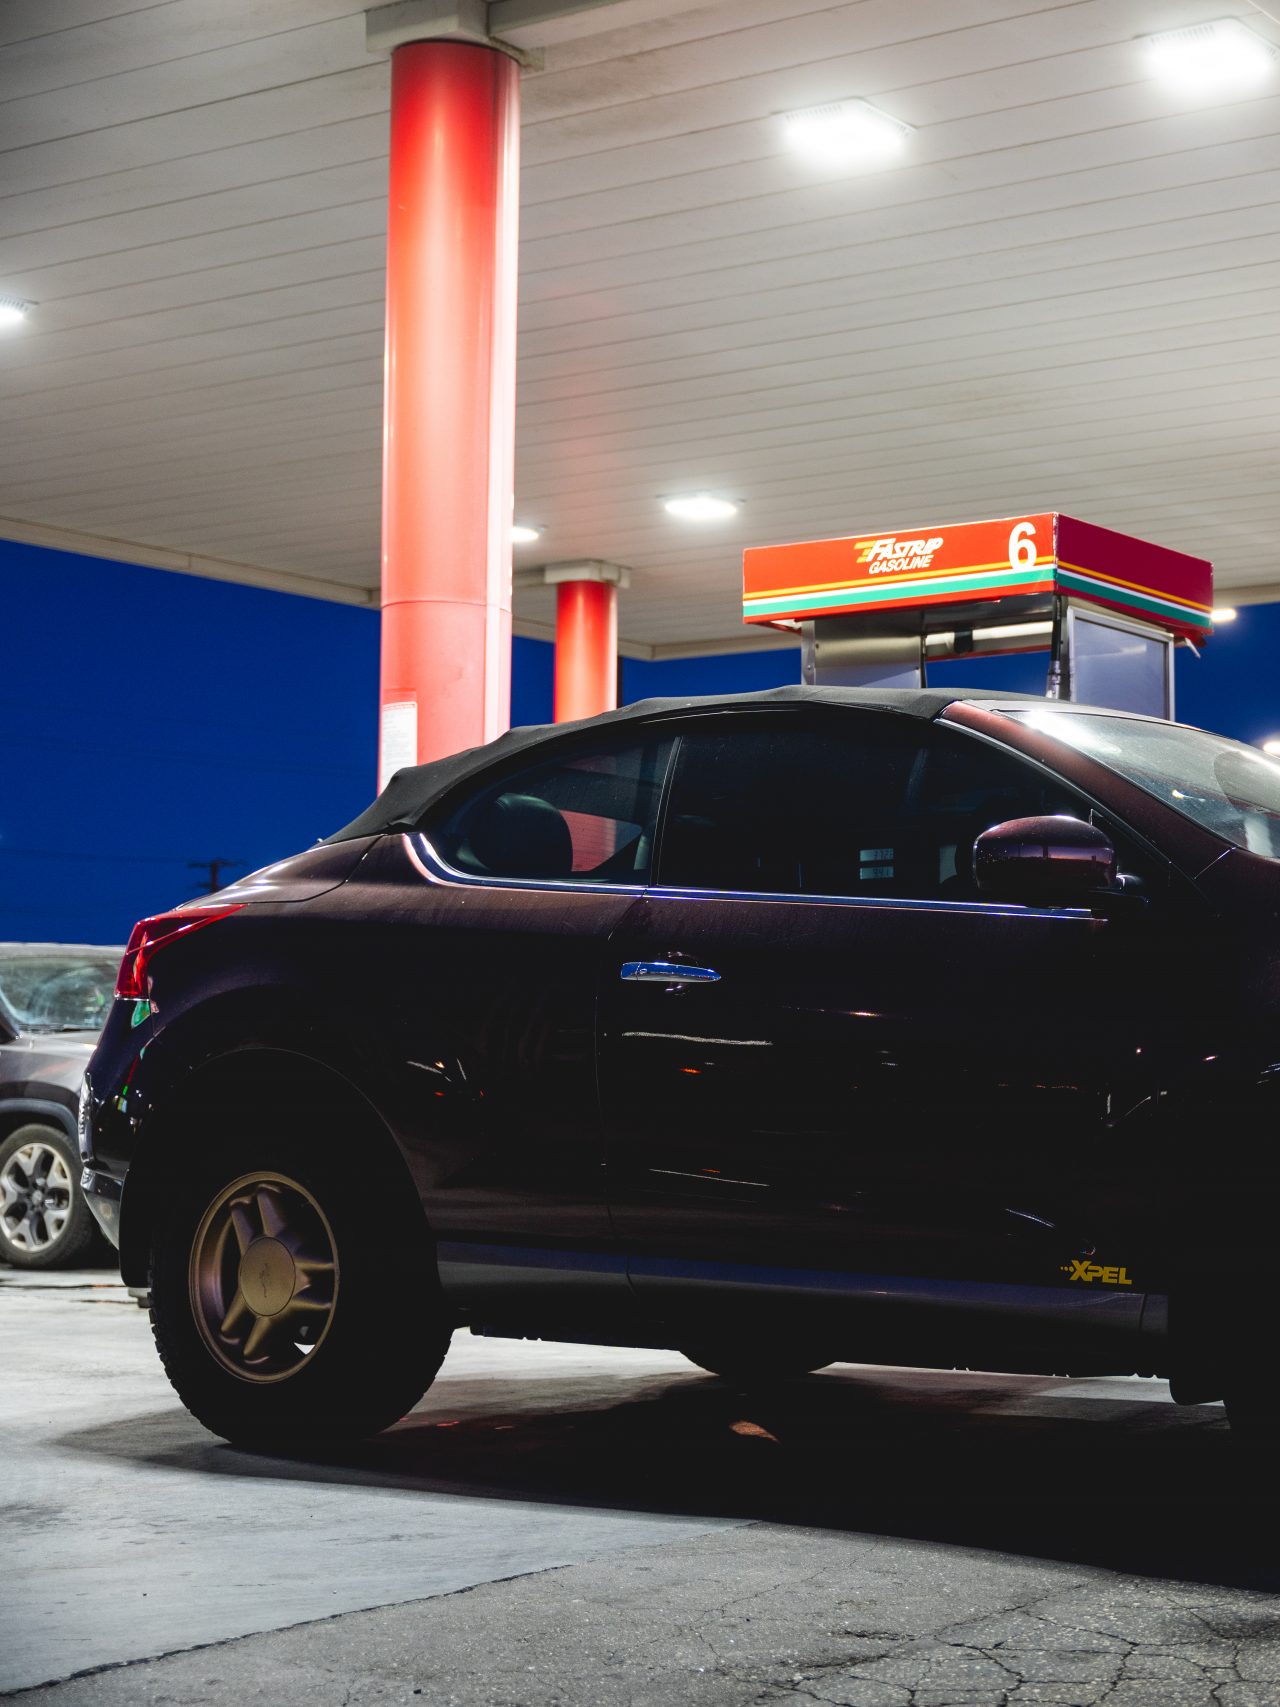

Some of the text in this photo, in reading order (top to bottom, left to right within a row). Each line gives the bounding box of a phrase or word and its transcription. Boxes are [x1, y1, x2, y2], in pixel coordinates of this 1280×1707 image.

[865, 537, 944, 562] FASTRIP
[1008, 521, 1037, 569] 6
[868, 554, 934, 575] GASOLINE
[1069, 1260, 1132, 1285] XPEL
